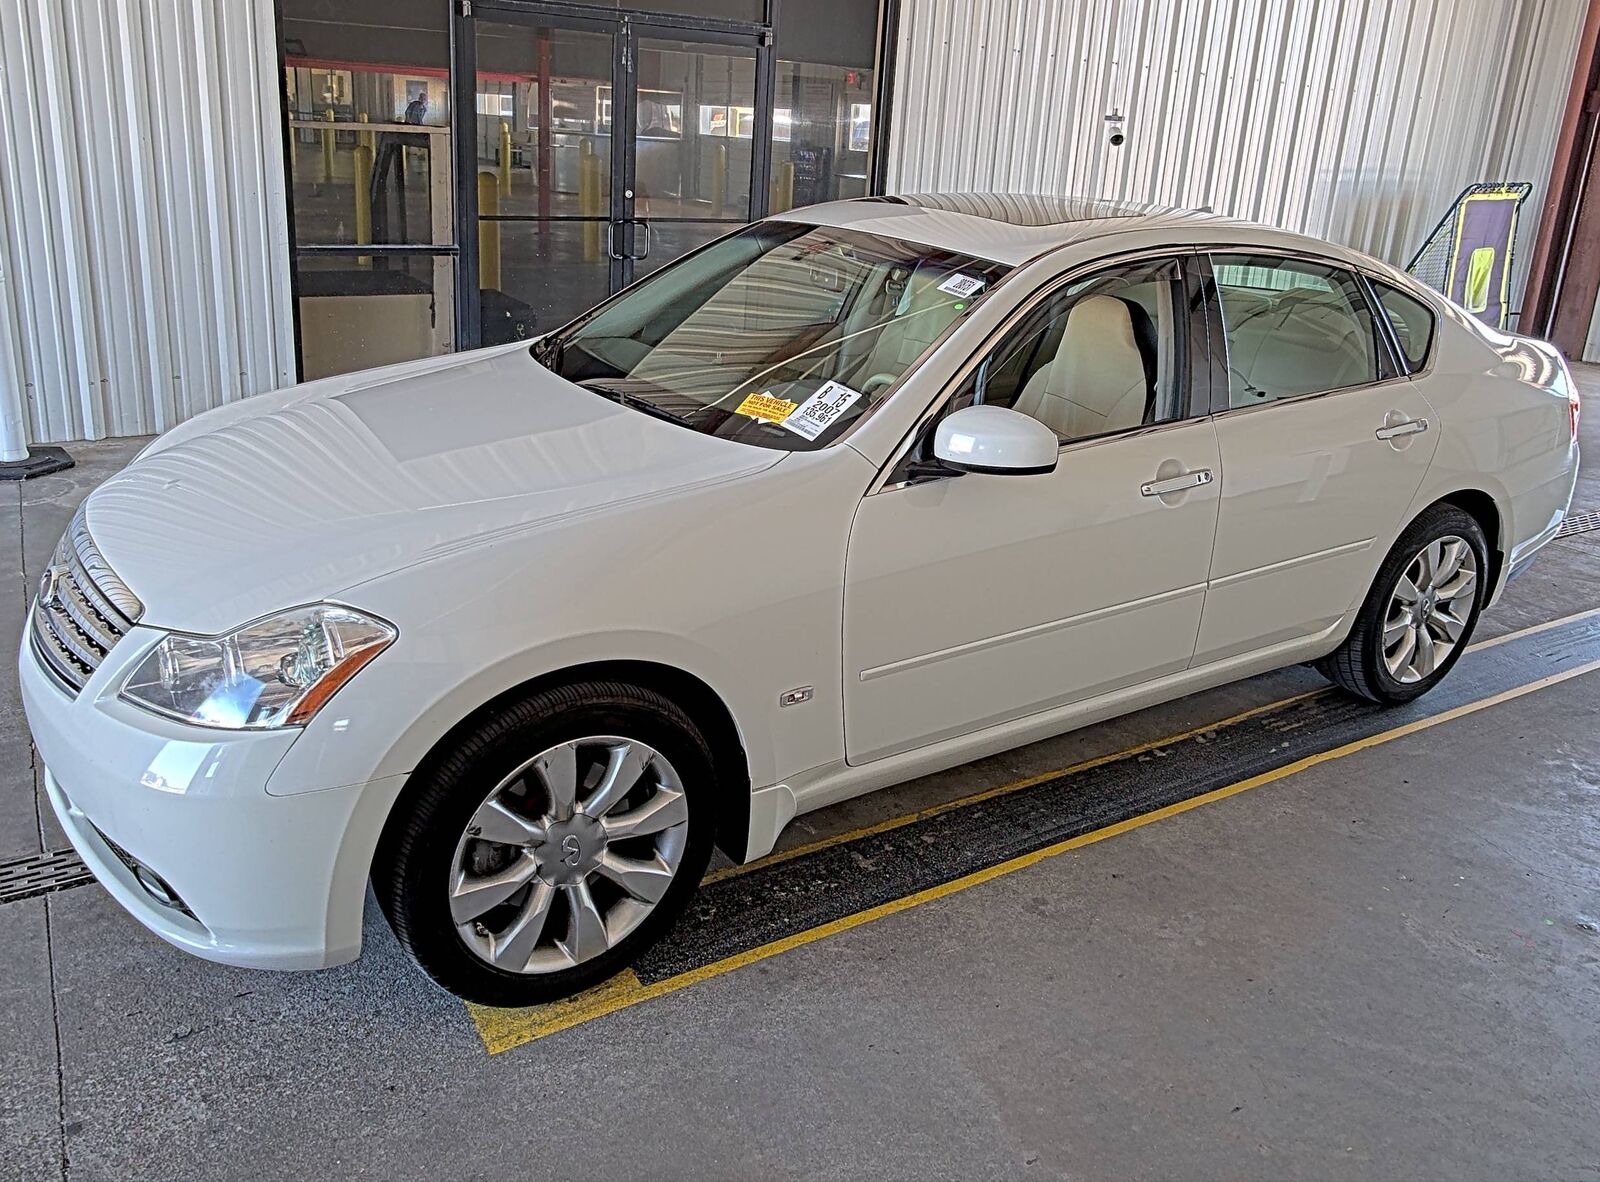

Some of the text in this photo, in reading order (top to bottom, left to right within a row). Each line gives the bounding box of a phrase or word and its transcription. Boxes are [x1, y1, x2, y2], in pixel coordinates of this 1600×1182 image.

[751, 394, 794, 409] THIS VEHICLE
[817, 385, 852, 408] B 15
[772, 404, 788, 413] SALE
[802, 406, 832, 425] 135,961
[812, 400, 841, 416] 2007
